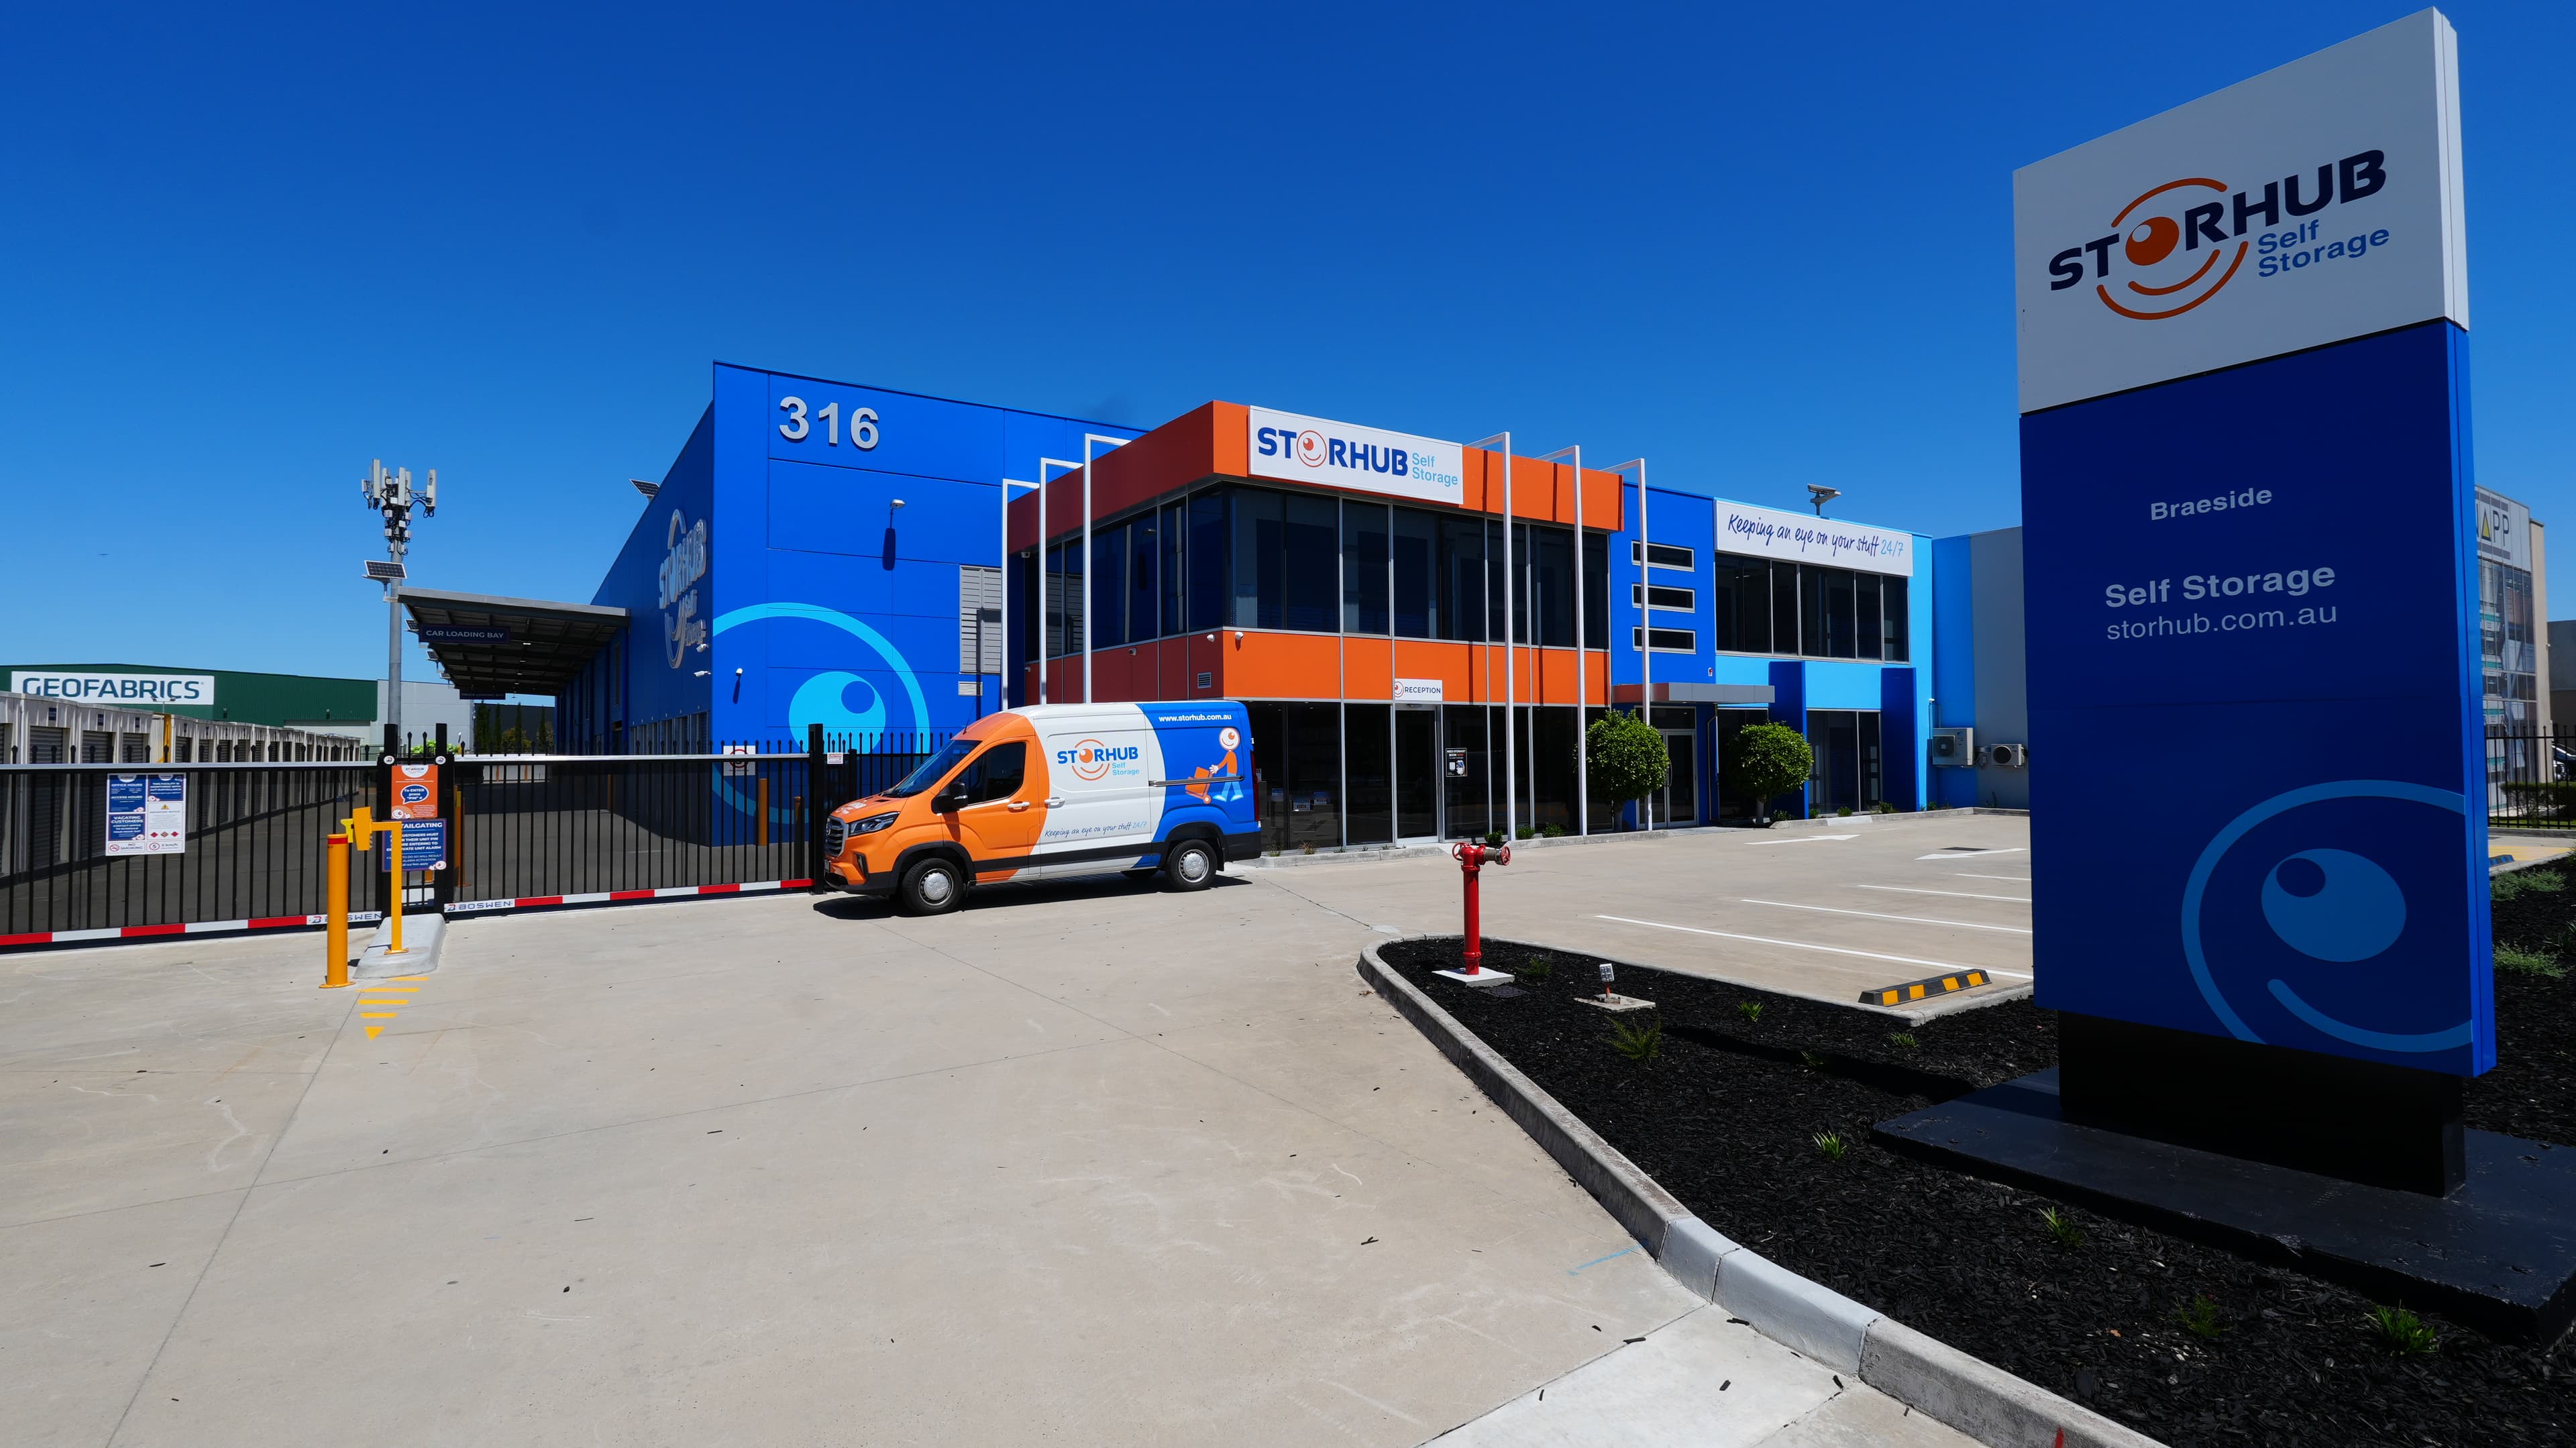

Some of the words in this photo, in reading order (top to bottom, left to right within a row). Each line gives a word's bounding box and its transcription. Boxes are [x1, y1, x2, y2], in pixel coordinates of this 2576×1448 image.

[2048, 149, 2387, 291] STORHUB
[2257, 219, 2319, 255] Self
[2258, 229, 2390, 278] Storage
[779, 396, 879, 450] 316
[1257, 427, 1408, 476] STORHUB
[1411, 452, 1435, 468] Self
[1411, 467, 1458, 487] Storage
[2150, 487, 2273, 521] Braeside
[1727, 513, 1774, 546] Keeping
[1777, 525, 1791, 541] an
[1795, 527, 1814, 552] eye
[1816, 532, 1828, 546] on
[1832, 534, 1856, 557] your
[1856, 535, 1880, 557] stuff
[1880, 539, 1904, 558] 24/7
[2477, 503, 2510, 547] APP
[2105, 578, 2171, 608] Self
[2183, 566, 2335, 600] Storage
[2106, 606, 2337, 640] storhub.com.au
[22, 677, 200, 699] GEOFABRICS
[1159, 713, 1232, 723] www.storhub.com.au
[1057, 746, 1138, 764] STORHUB
[1112, 762, 1126, 770] Self
[1112, 768, 1140, 777] Storage
[1044, 828, 1069, 838] Keeping
[1081, 827, 1092, 837] eye
[1103, 825, 1117, 834] your
[1118, 821, 1132, 831] stuff
[1132, 821, 1147, 829] 24/7
[458, 900, 511, 910] BOSWEN
